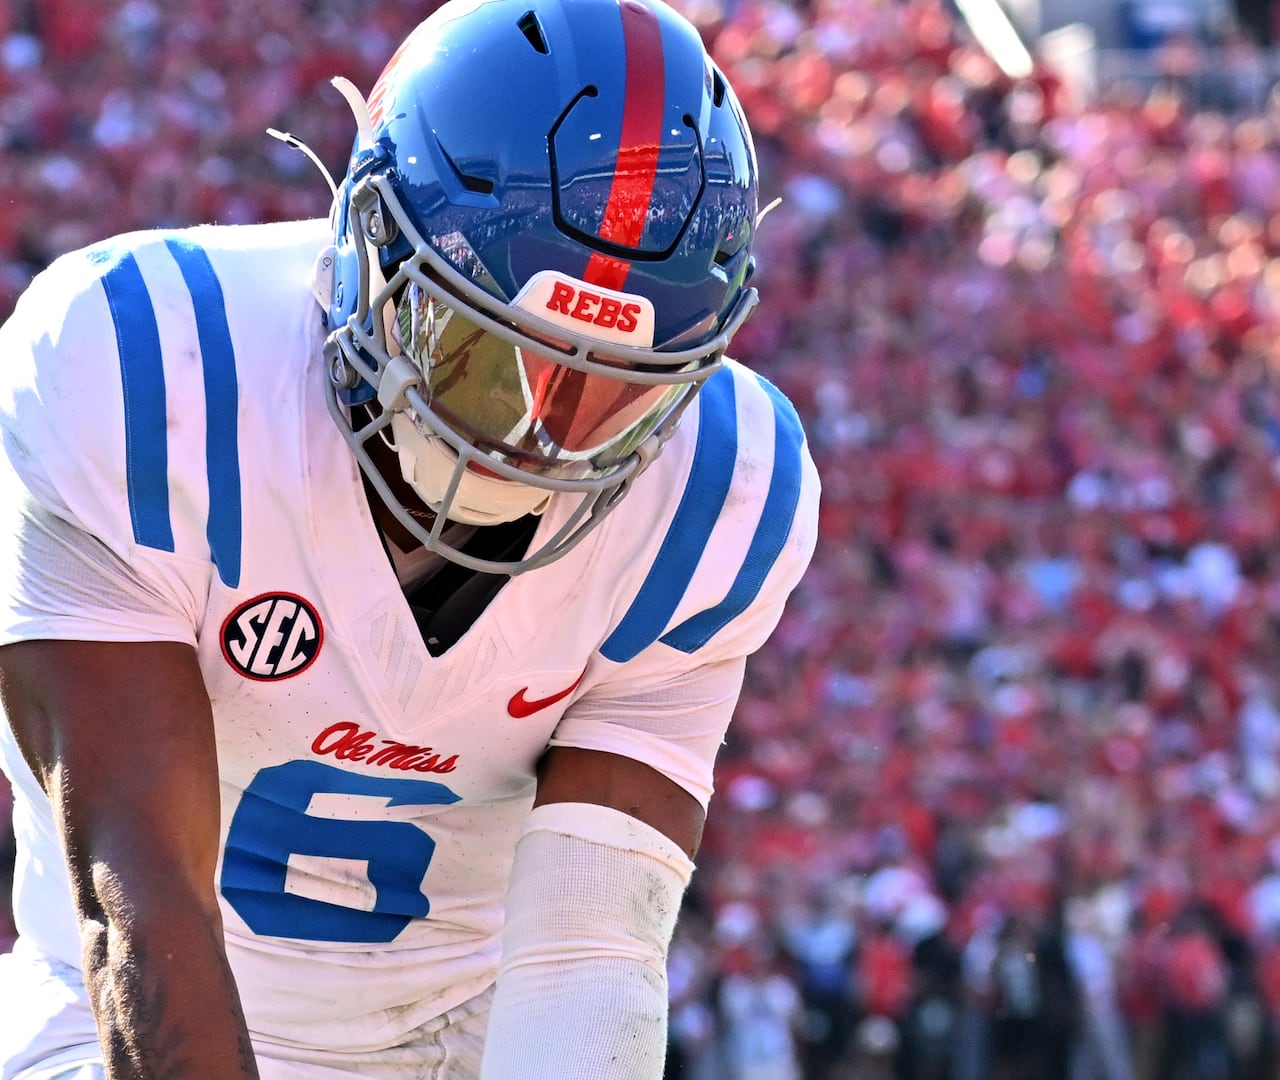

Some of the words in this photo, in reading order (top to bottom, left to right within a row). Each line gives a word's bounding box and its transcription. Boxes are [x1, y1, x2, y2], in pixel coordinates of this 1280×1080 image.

[545, 281, 642, 334] REBS
[228, 598, 317, 677] SEC
[311, 721, 377, 762] Ole
[365, 739, 460, 774] Miss
[220, 759, 464, 943] 6
